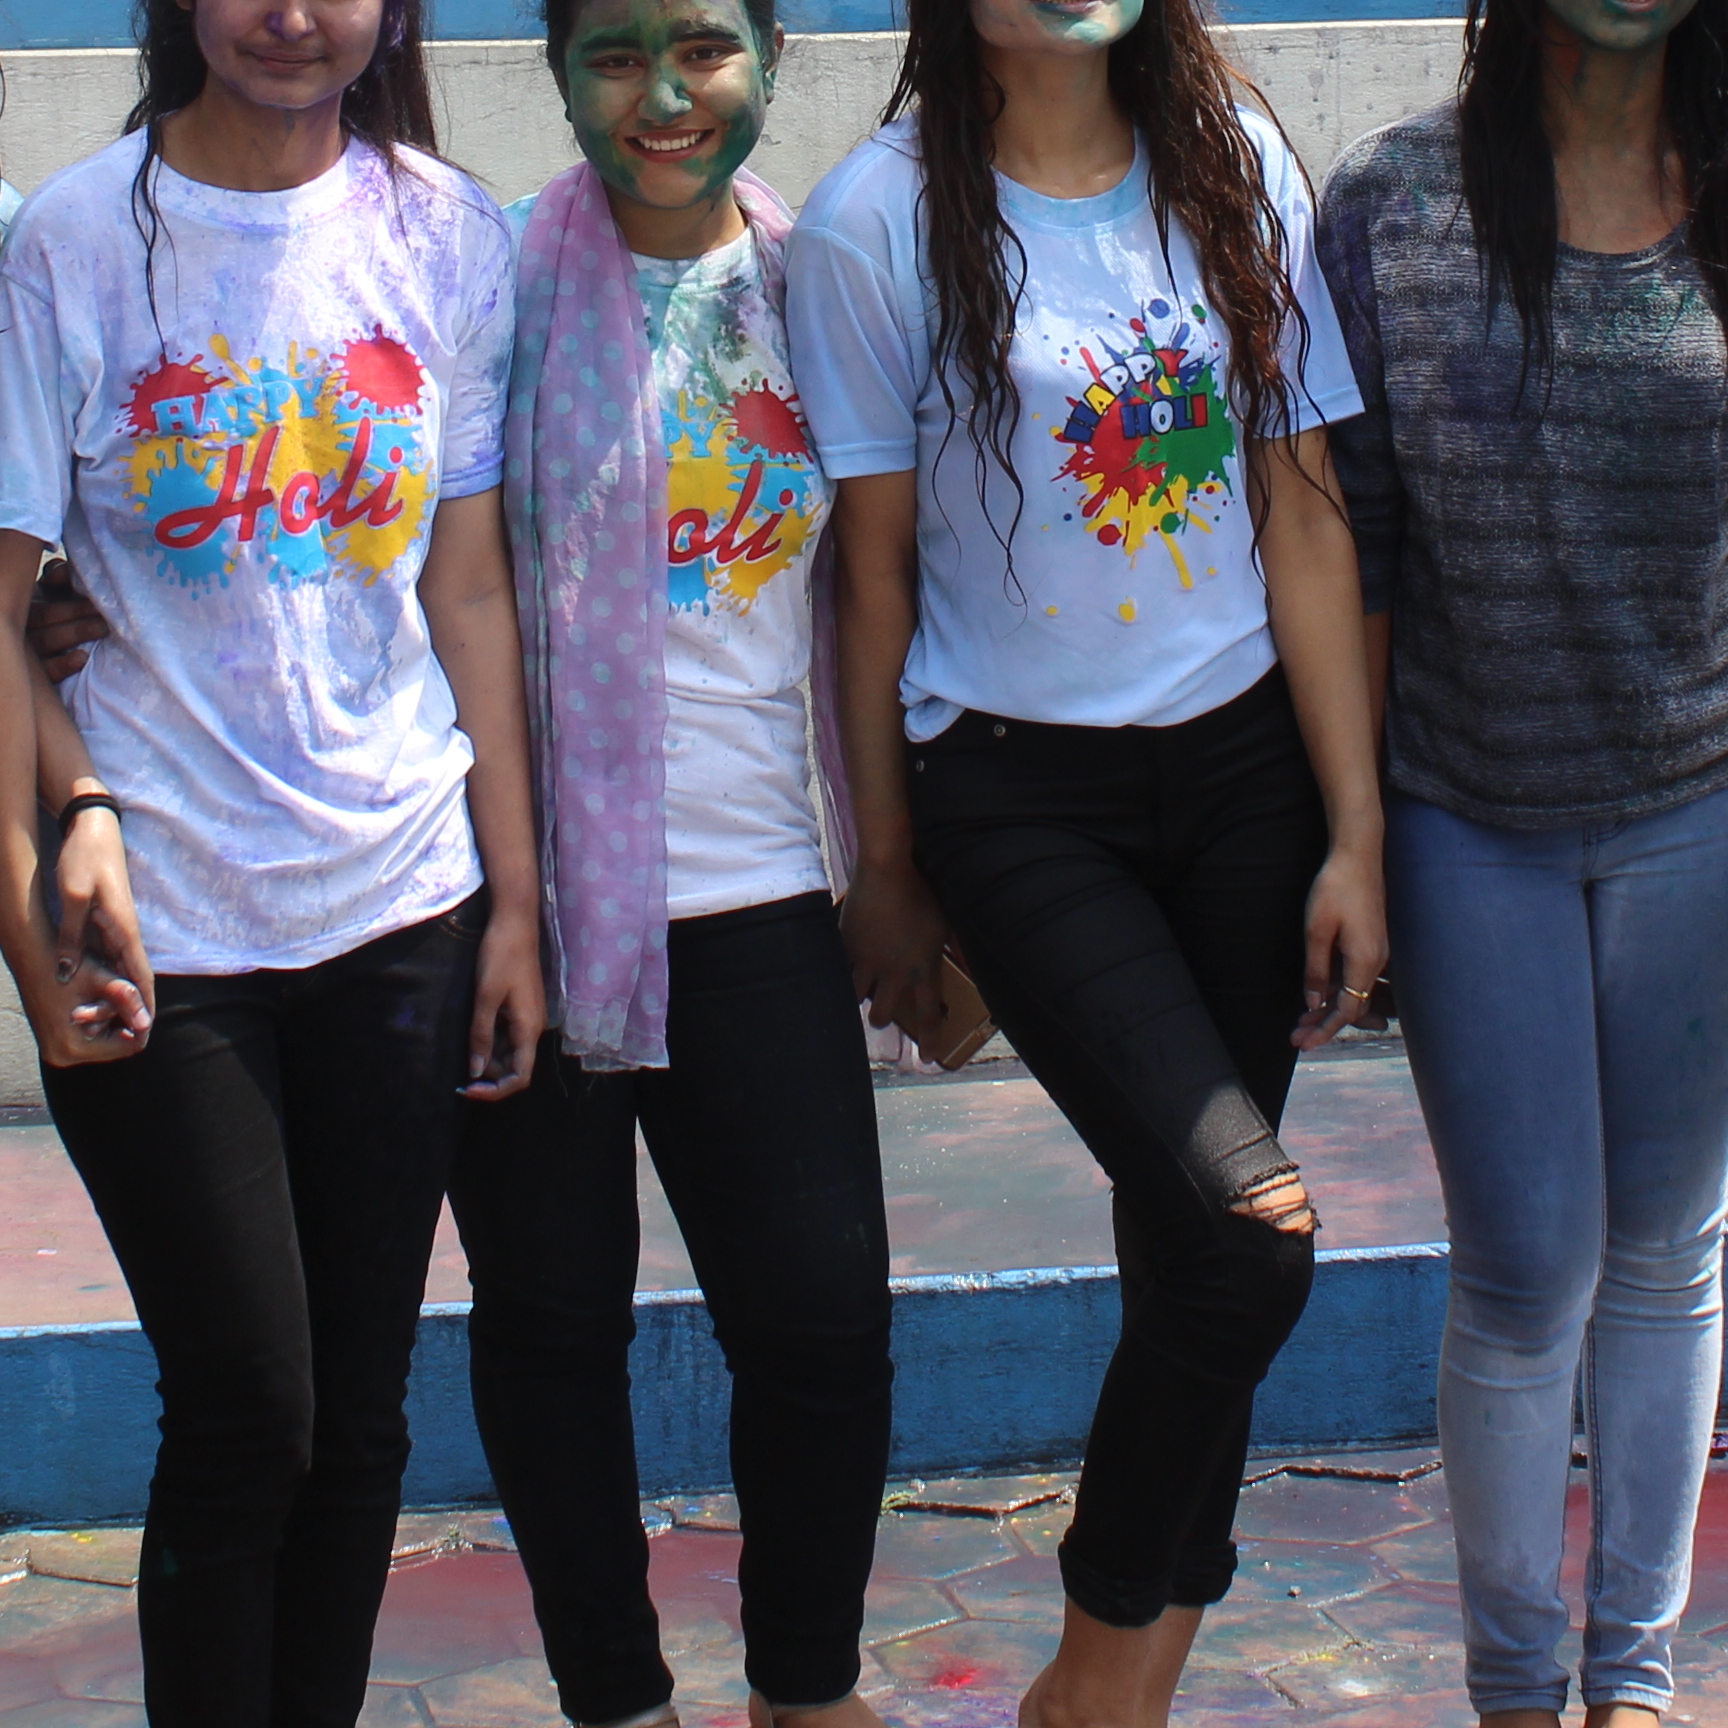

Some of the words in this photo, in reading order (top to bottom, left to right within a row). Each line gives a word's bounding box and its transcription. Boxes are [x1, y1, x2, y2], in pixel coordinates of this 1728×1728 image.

[151, 375, 325, 438] HAPPY
[1063, 348, 1189, 444] HAPPY
[1119, 391, 1208, 440] HOLI
[154, 415, 406, 550] Holi
[668, 459, 796, 565] oli
